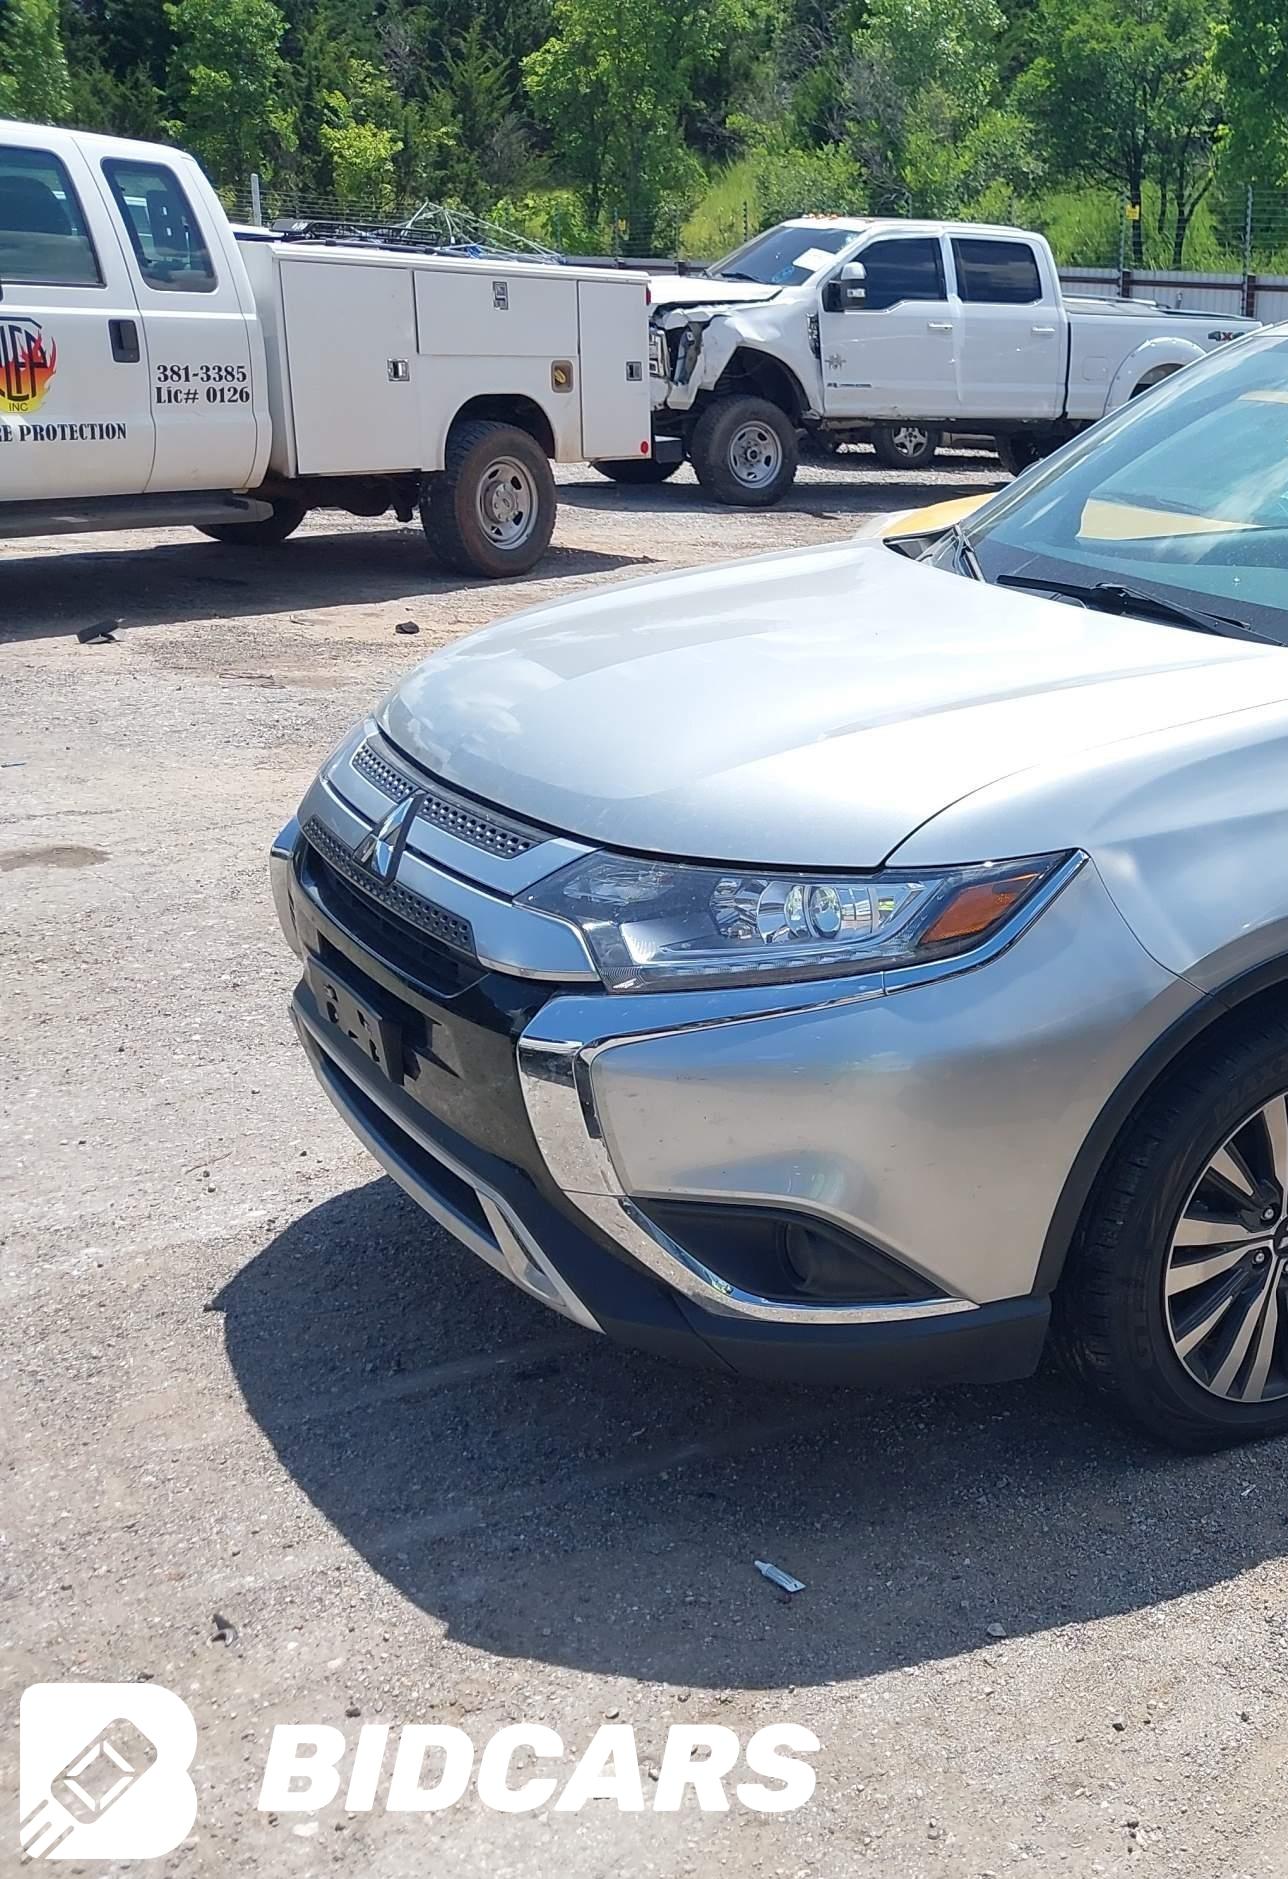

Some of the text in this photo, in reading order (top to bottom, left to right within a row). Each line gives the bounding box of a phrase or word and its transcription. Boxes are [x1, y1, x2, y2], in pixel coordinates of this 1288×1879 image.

[157, 364, 247, 383] 381-3385
[155, 386, 250, 404] Lic# 0126
[9, 402, 29, 412] INC
[19, 422, 127, 441] PROTECTION
